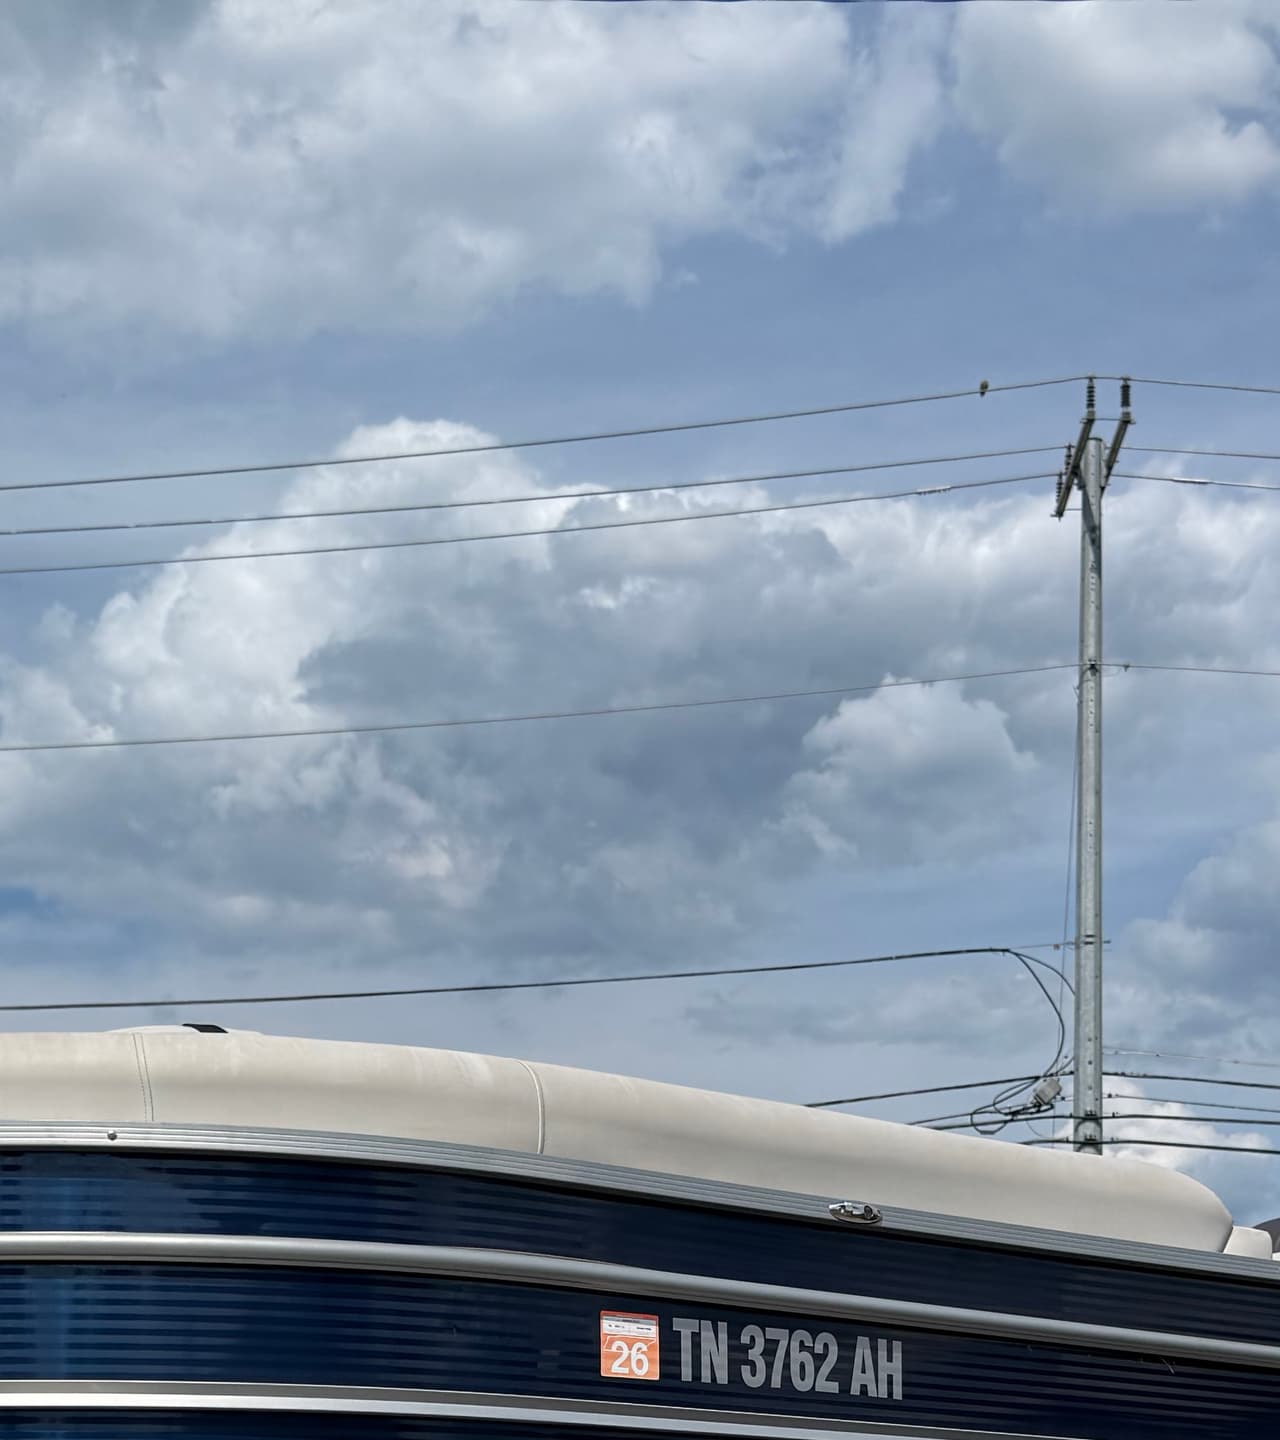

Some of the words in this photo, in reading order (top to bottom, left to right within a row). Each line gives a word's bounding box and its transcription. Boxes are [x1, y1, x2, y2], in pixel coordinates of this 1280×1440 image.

[609, 1340, 650, 1378] 26
[672, 1317, 729, 1385] TN
[740, 1324, 840, 1394] 3762
[849, 1335, 903, 1400] AH
